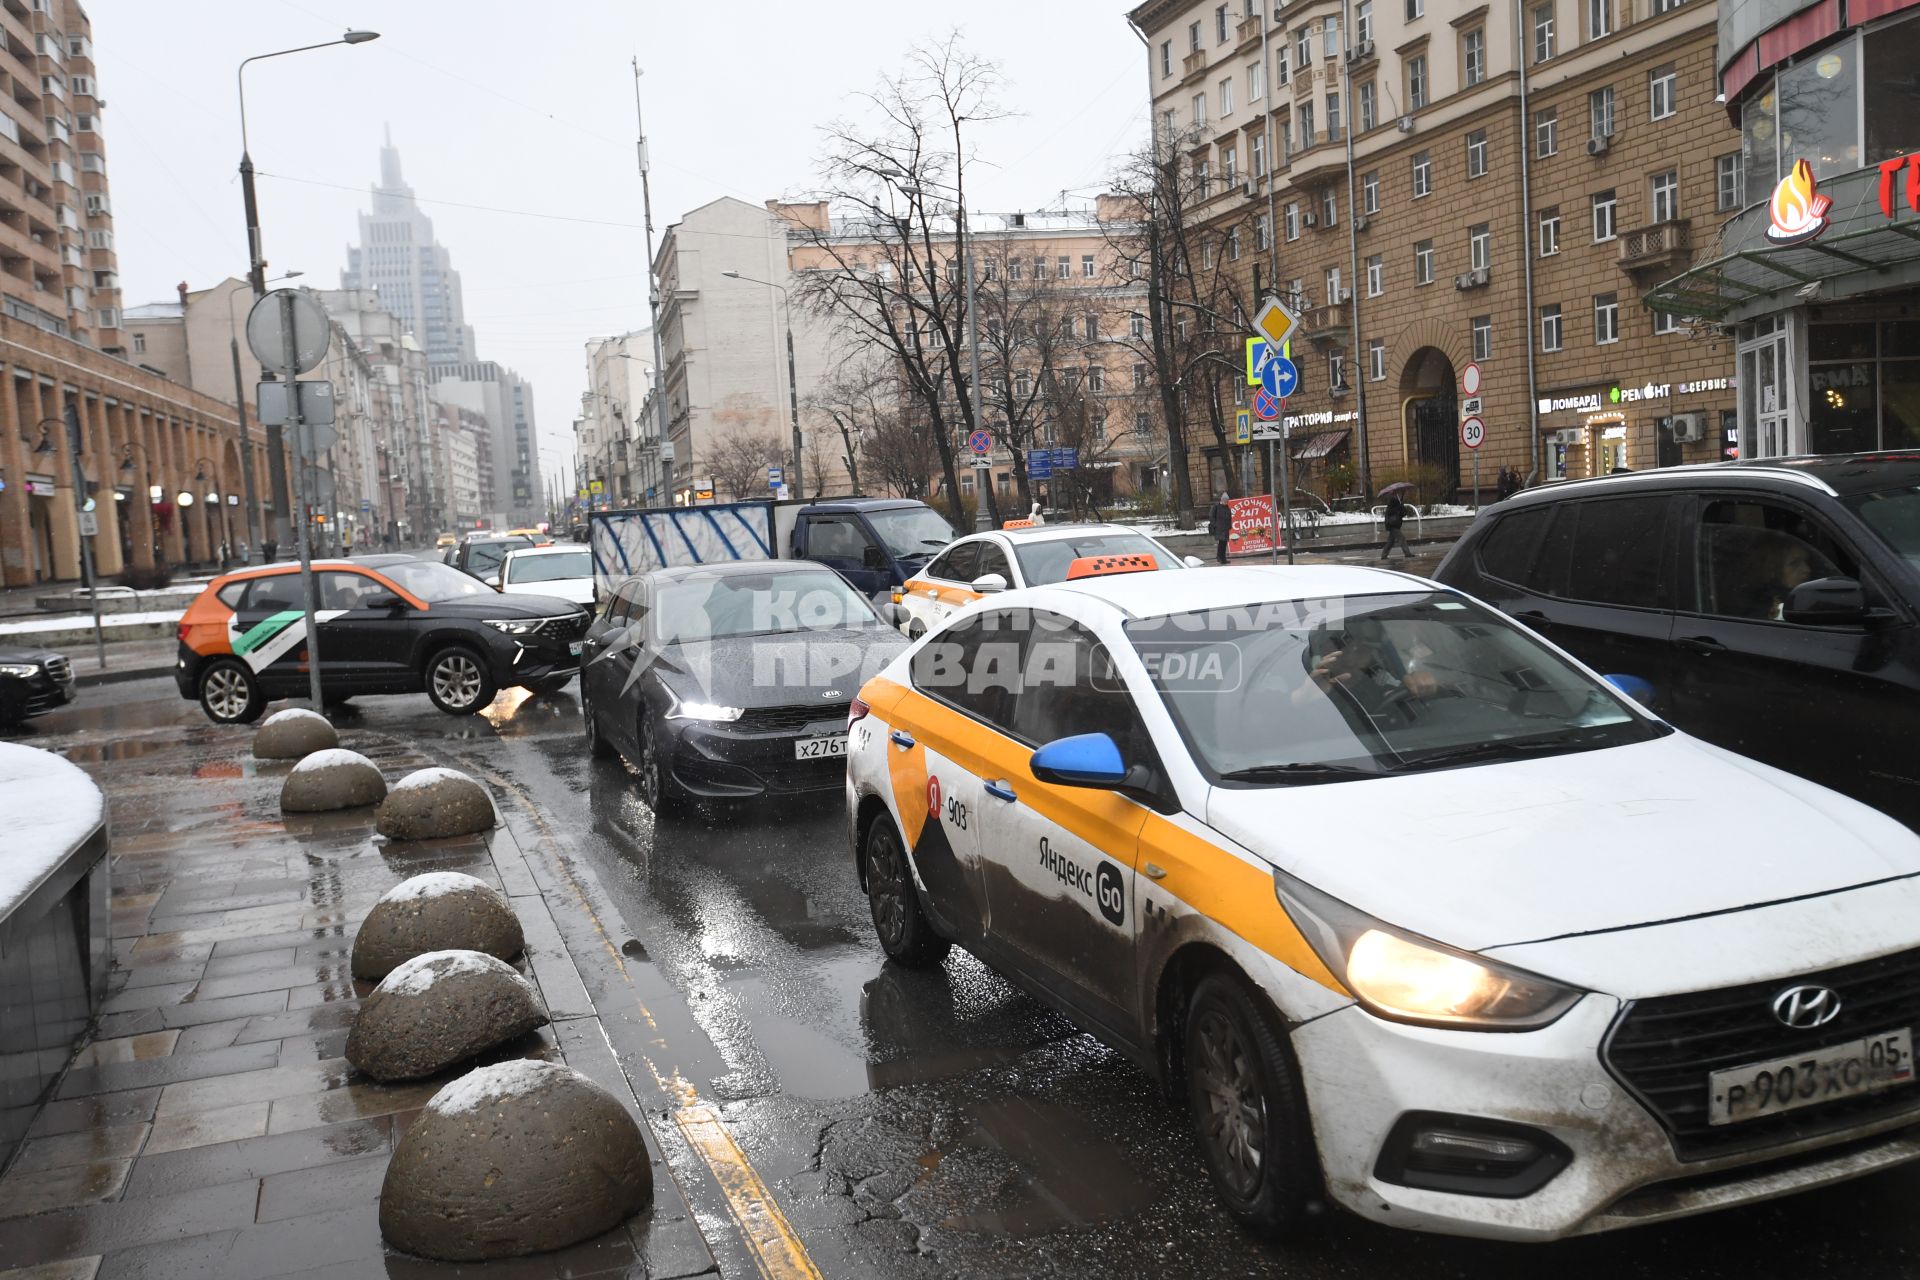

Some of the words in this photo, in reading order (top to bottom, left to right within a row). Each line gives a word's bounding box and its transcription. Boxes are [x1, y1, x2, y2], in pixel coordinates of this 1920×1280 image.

[1689, 379, 1727, 393] СЕРВИС
[1552, 394, 1598, 411] ЛОМБАРД
[1284, 411, 1333, 428] ТРАТТОРИЯ
[1334, 410, 1359, 423] semplce
[1466, 426, 1481, 441] 30
[1231, 499, 1273, 517] ВЕТОЧНЫ
[1240, 508, 1260, 517] 24/7
[1232, 516, 1272, 531] СКЛАД
[825, 690, 841, 698] KIA
[930, 784, 938, 811] Я
[948, 796, 968, 831] 903
[1039, 836, 1093, 898] Яндекс
[1101, 872, 1122, 914] Go
[1869, 1036, 1900, 1069] 05
